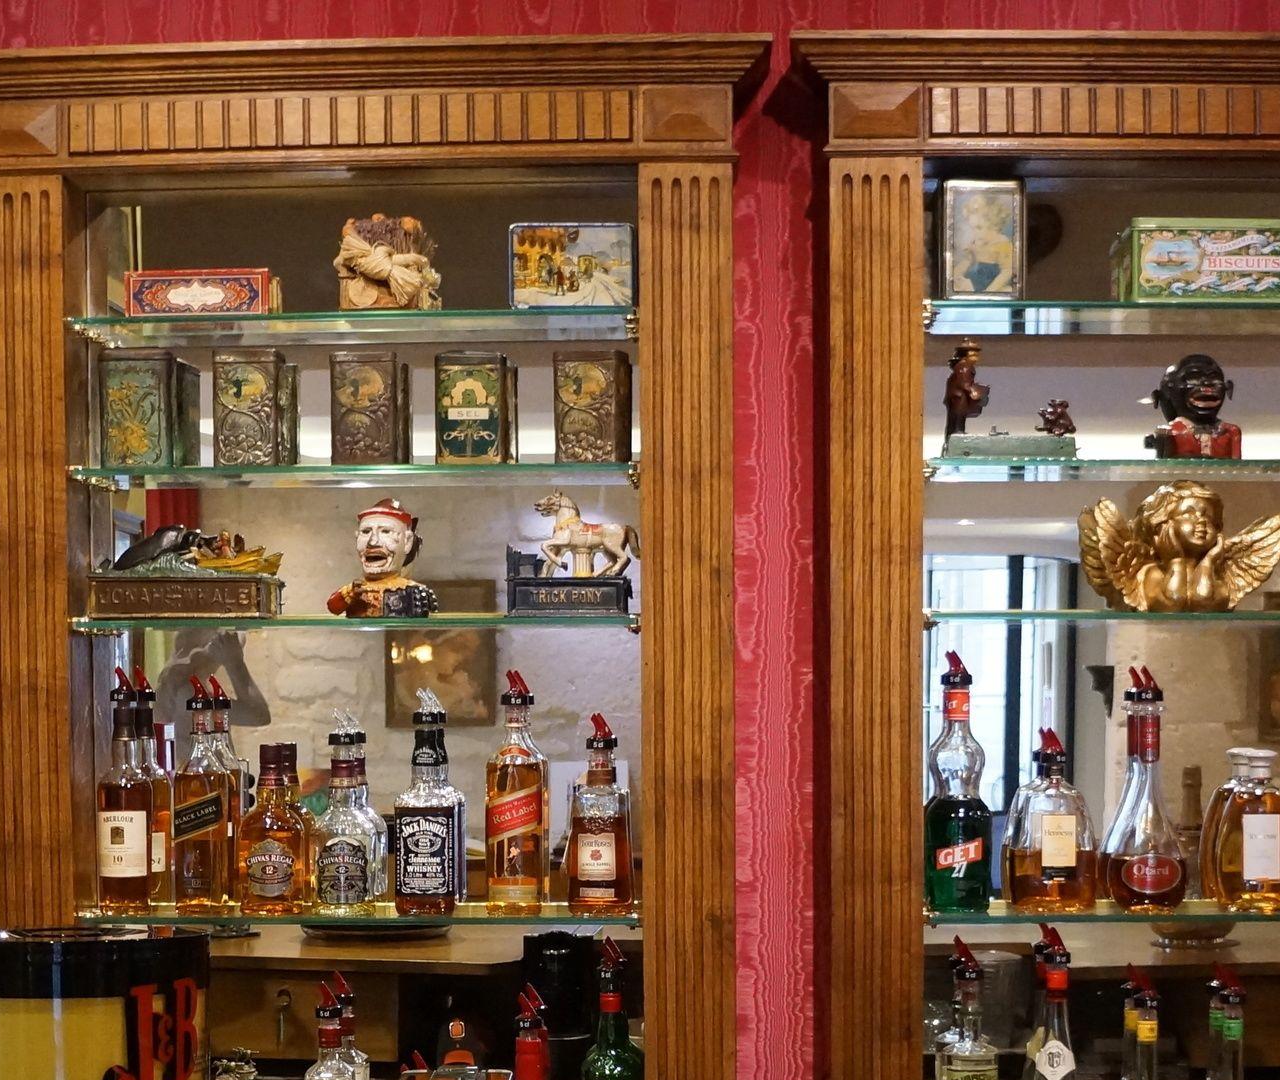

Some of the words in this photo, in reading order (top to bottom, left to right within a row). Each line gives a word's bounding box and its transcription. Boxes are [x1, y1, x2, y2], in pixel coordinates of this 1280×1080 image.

[1208, 257, 1280, 268] BISCUITS
[530, 588, 567, 604] TRICK
[571, 588, 602, 603] PONY
[175, 813, 195, 825] BLACK
[196, 805, 218, 818] LABEL
[492, 811, 511, 824] Red
[512, 804, 538, 818] Label
[402, 821, 419, 838] JACK
[113, 855, 123, 863] 10
[246, 854, 270, 866] CHIVAS
[270, 854, 293, 865] REGAL
[938, 841, 979, 865] GET
[320, 856, 343, 866] CHIVAS
[344, 856, 366, 866] REGAL
[265, 866, 274, 874] 12
[950, 861, 968, 878] 27
[1133, 863, 1169, 876] Otard
